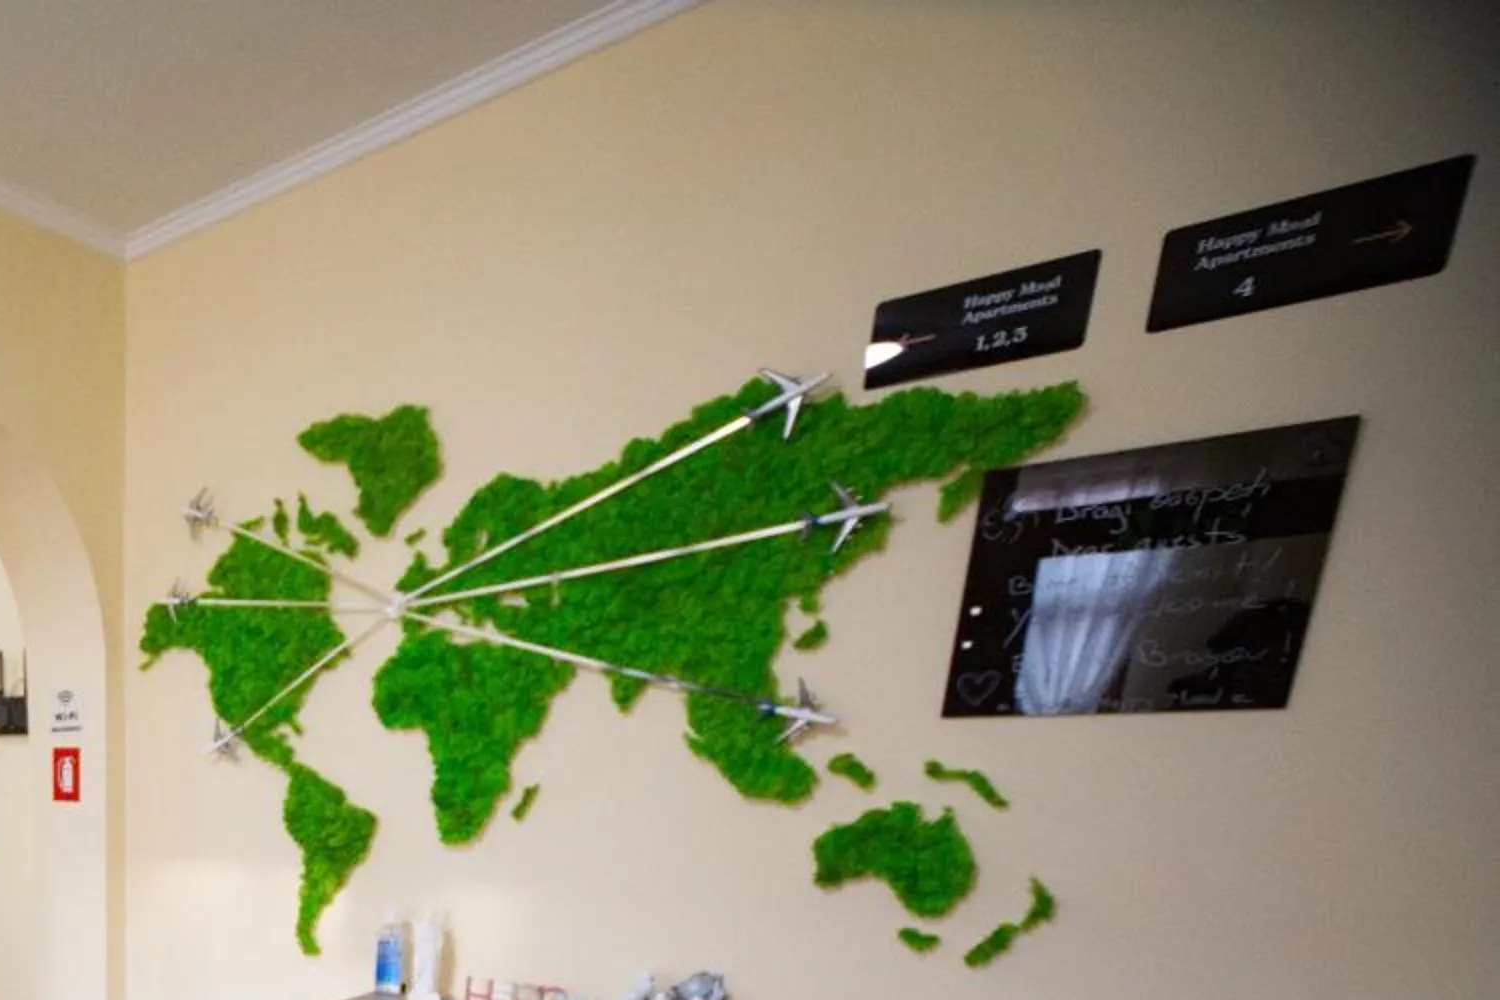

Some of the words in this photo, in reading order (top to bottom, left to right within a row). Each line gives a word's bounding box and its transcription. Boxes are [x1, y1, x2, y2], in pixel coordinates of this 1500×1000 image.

[1197, 228, 1263, 254] Happy
[1266, 210, 1322, 237] Mood
[1191, 233, 1317, 271] Apartments
[963, 288, 1016, 309] Happy
[1019, 274, 1062, 297] Mood
[1232, 275, 1256, 298] 4
[962, 294, 1059, 325] Apartments
